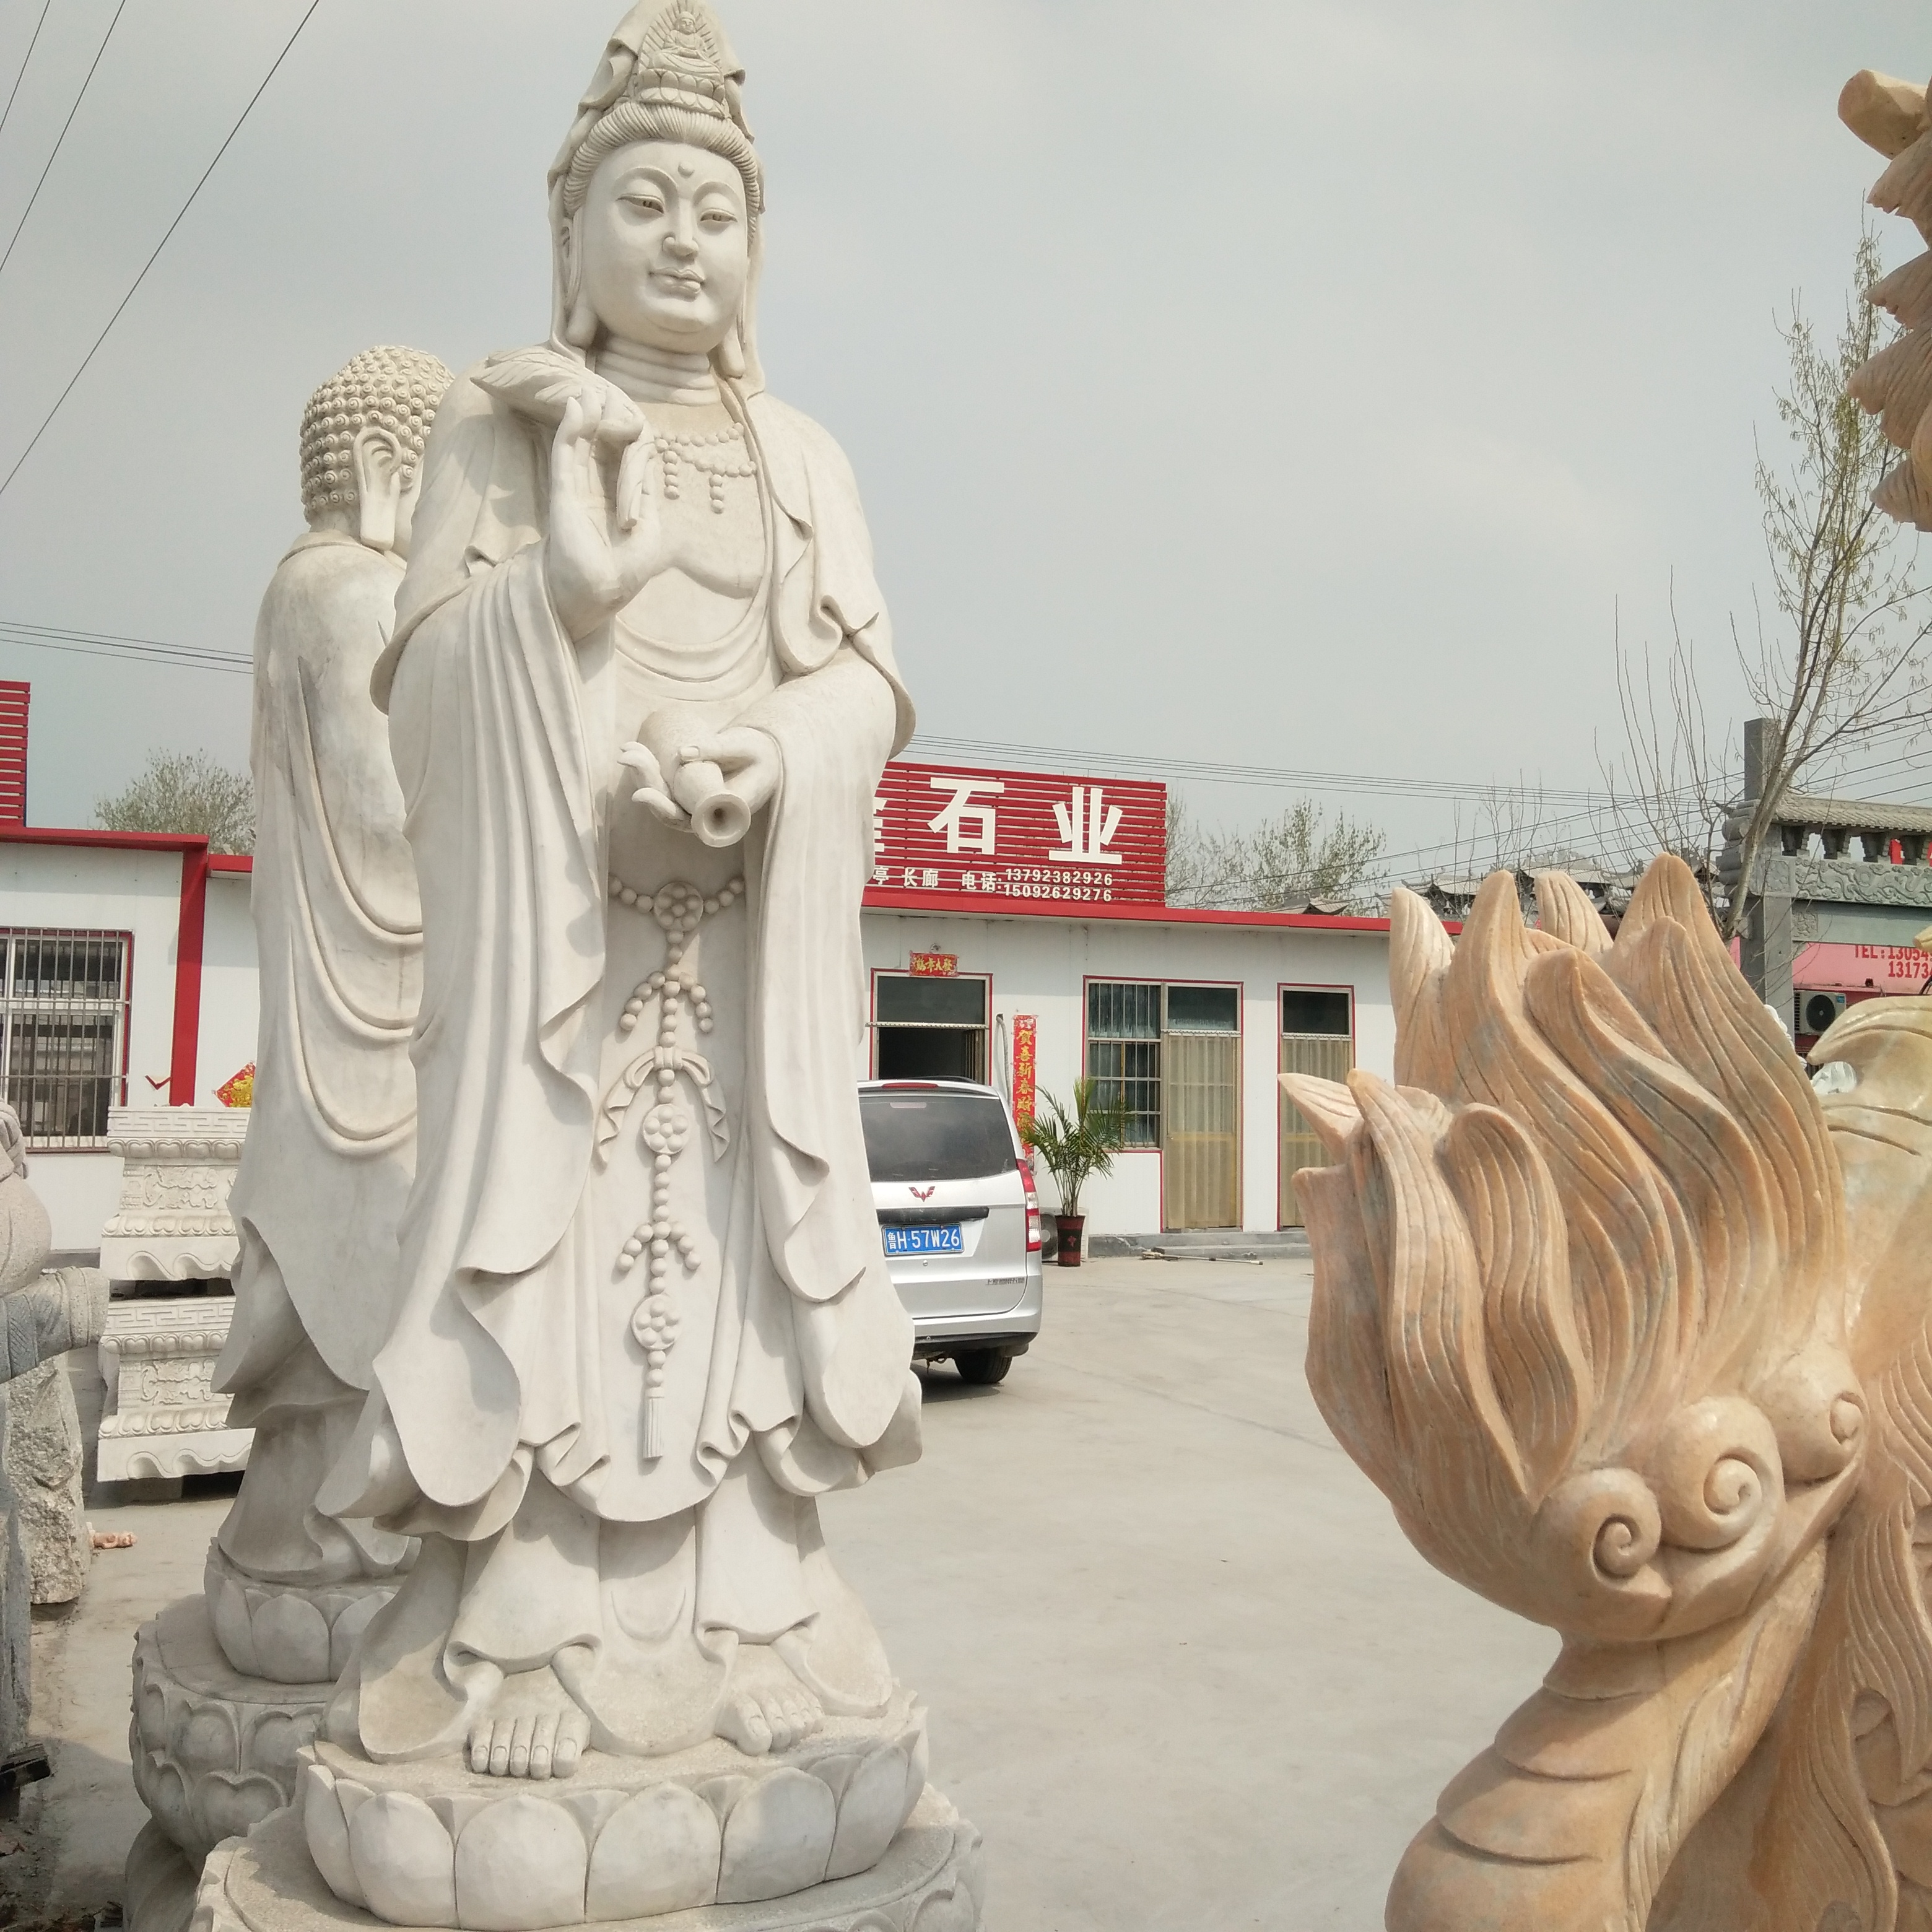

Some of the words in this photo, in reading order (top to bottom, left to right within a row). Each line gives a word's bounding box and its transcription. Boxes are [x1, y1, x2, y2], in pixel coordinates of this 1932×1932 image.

[874, 778, 1123, 864] 石业
[902, 868, 939, 888] 长廊
[1005, 868, 1113, 886] 13792382926
[1004, 884, 1112, 902] 15092629276
[1888, 960, 1932, 979] 13173
